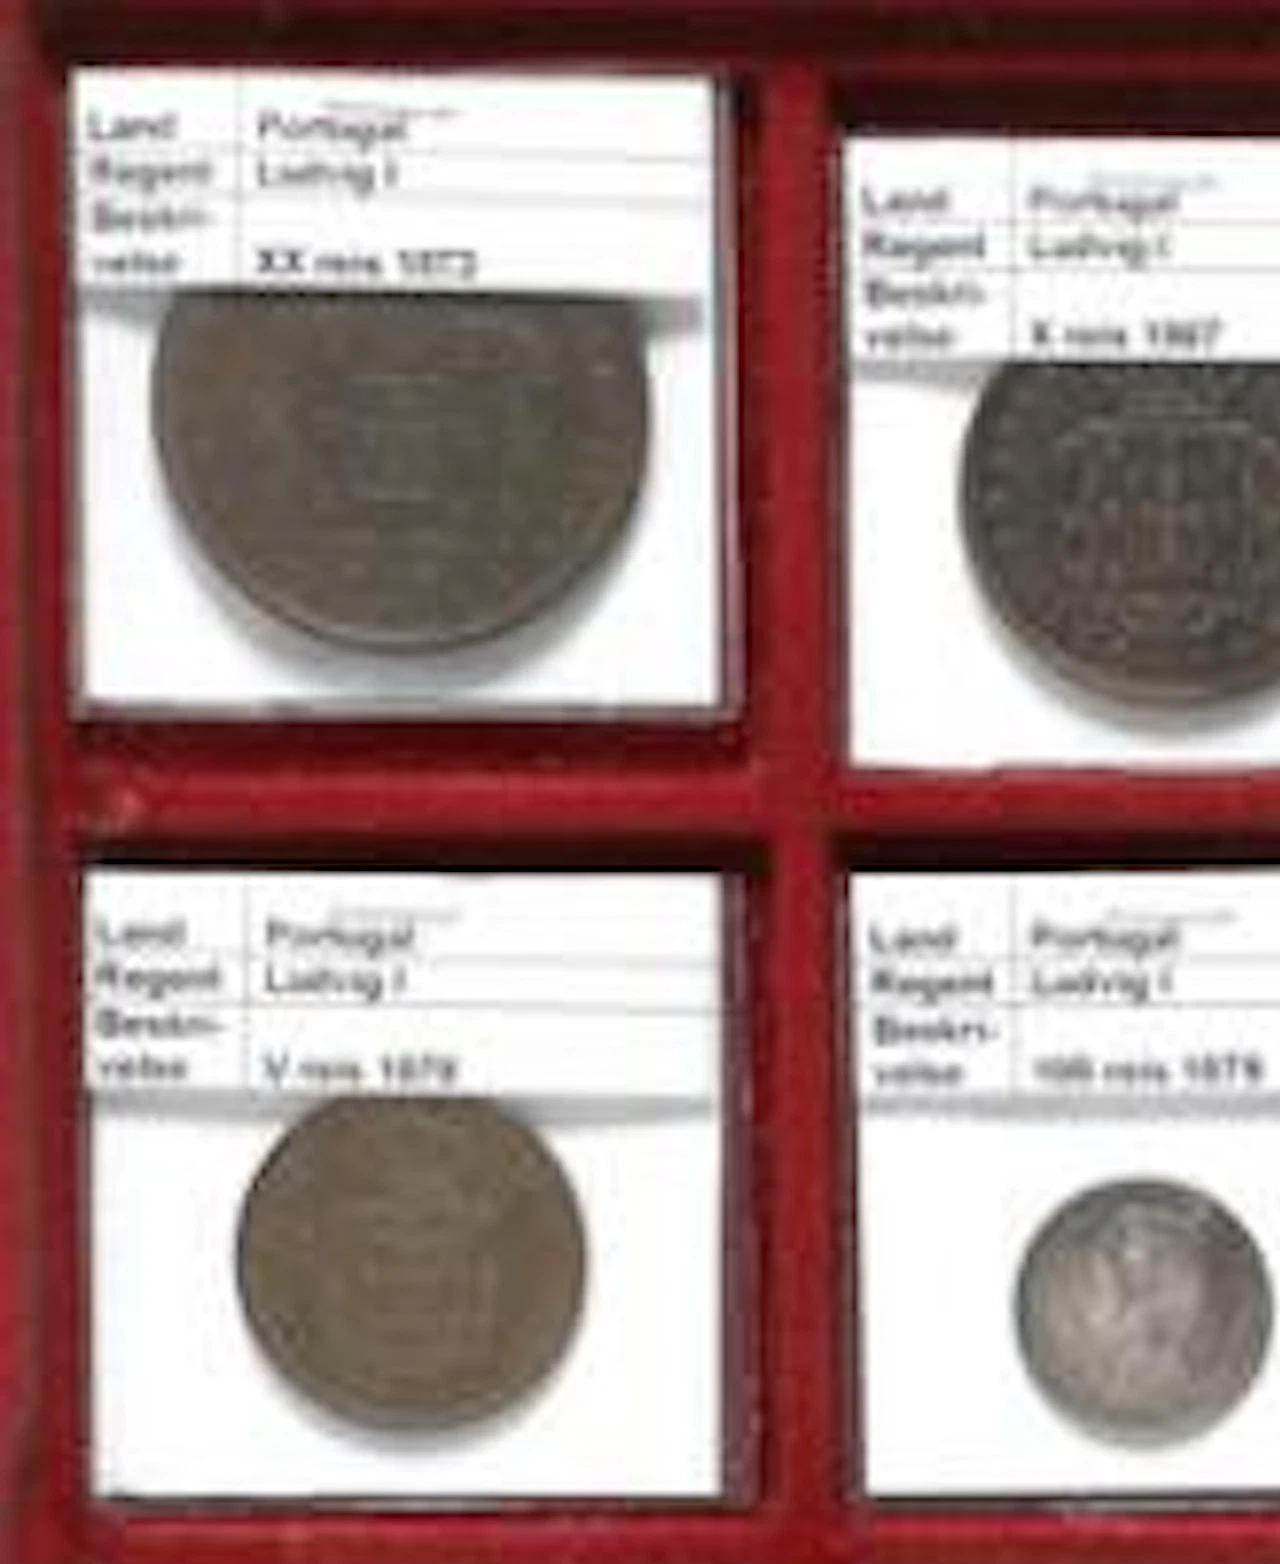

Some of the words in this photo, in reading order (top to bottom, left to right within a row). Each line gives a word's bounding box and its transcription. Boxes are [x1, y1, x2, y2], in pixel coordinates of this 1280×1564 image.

[86, 115, 176, 143] Land
[256, 110, 408, 154] Portugal
[87, 154, 212, 196] Regent
[256, 160, 376, 198] Ludvig
[860, 186, 949, 219] Land
[1028, 186, 1179, 226] Portugal
[93, 249, 180, 276] velse
[860, 230, 987, 271] Regent
[1029, 233, 1150, 271] Ludvig
[865, 322, 954, 352] velse
[94, 918, 186, 951] Land
[264, 918, 416, 961] Portugal
[867, 926, 958, 956] Land
[1029, 922, 1180, 963] Portugal
[93, 959, 223, 1002] Regent
[264, 957, 385, 1004] Ludvig
[868, 966, 996, 1008] Regent
[1030, 970, 1151, 1008] Ludvig
[96, 1052, 188, 1085] velse
[874, 1061, 963, 1087] velse
